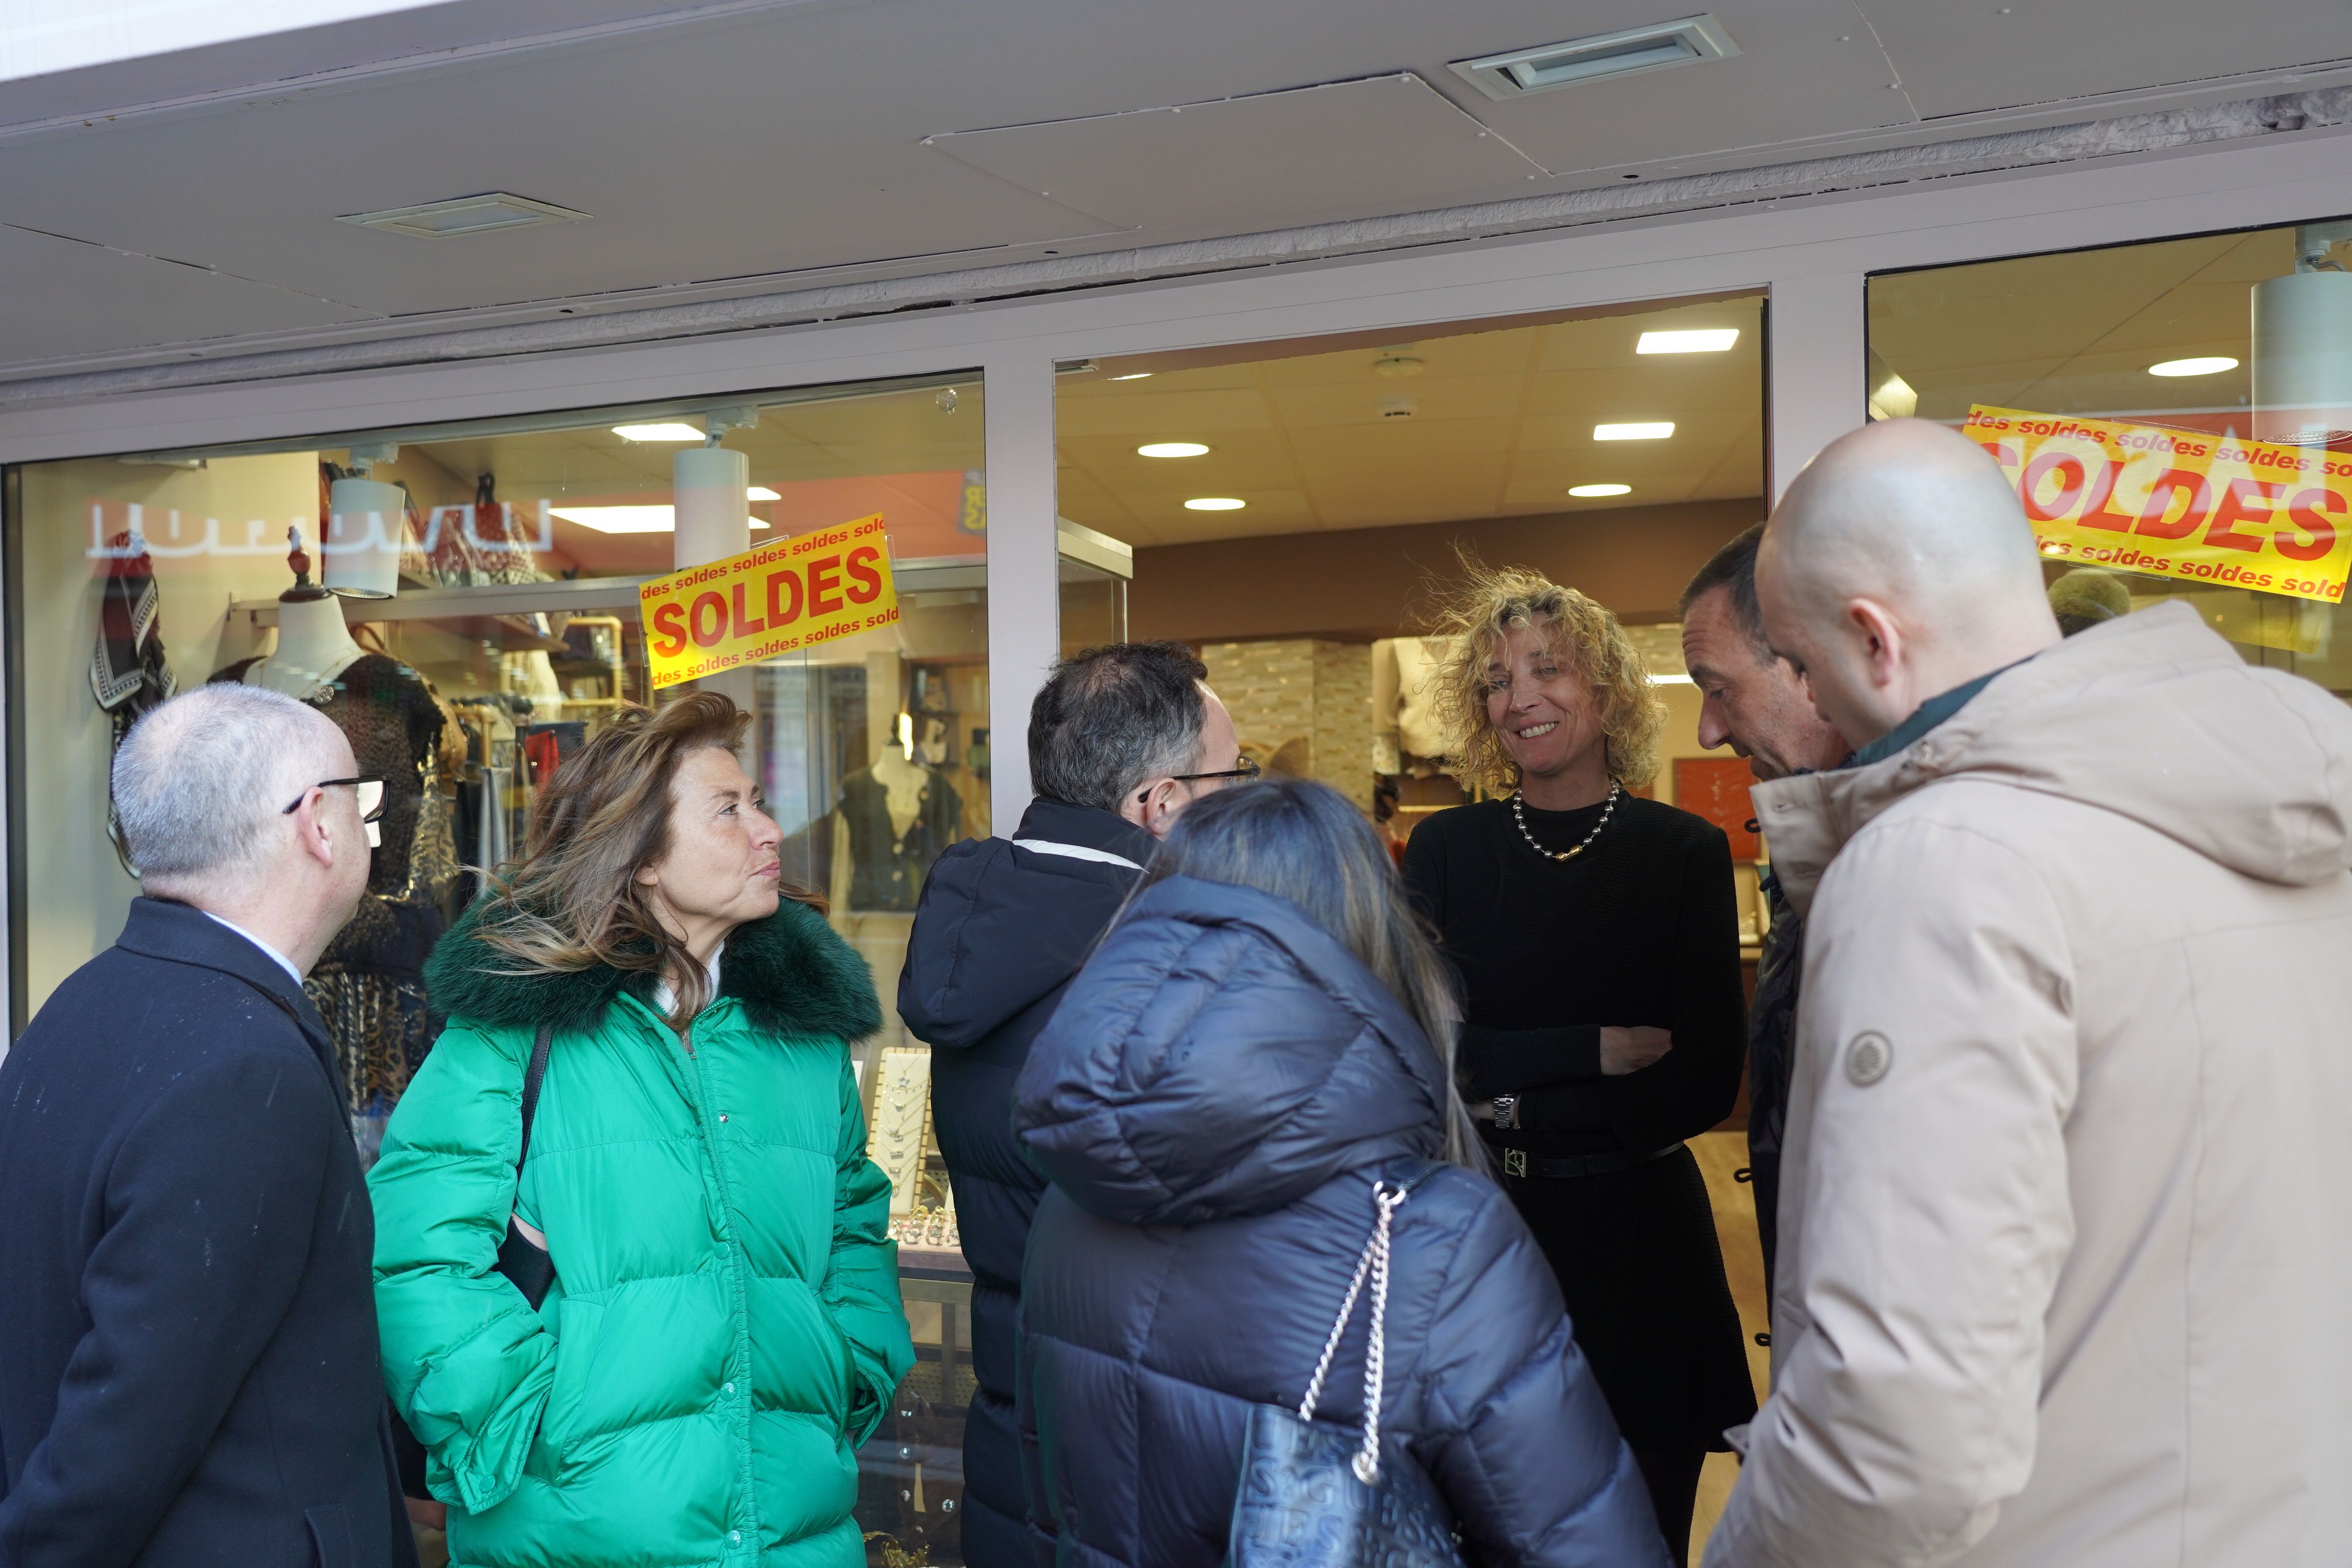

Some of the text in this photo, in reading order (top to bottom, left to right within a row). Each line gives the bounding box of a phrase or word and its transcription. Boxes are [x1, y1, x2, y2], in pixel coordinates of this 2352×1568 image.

[1965, 411, 2011, 430] des
[2018, 421, 2108, 443] soldes
[2115, 433, 2207, 457] soldes
[2215, 447, 2311, 471] soldes
[642, 584, 670, 600] des
[675, 566, 727, 590] soldes
[733, 549, 787, 572] soldes
[792, 531, 848, 555] soldes
[2080, 547, 2171, 571] soldes
[2178, 562, 2273, 586] soldes
[2281, 579, 2347, 598] sold
[653, 546, 881, 658] SOLDES
[651, 606, 899, 685] des soldes soldes soldes sold
